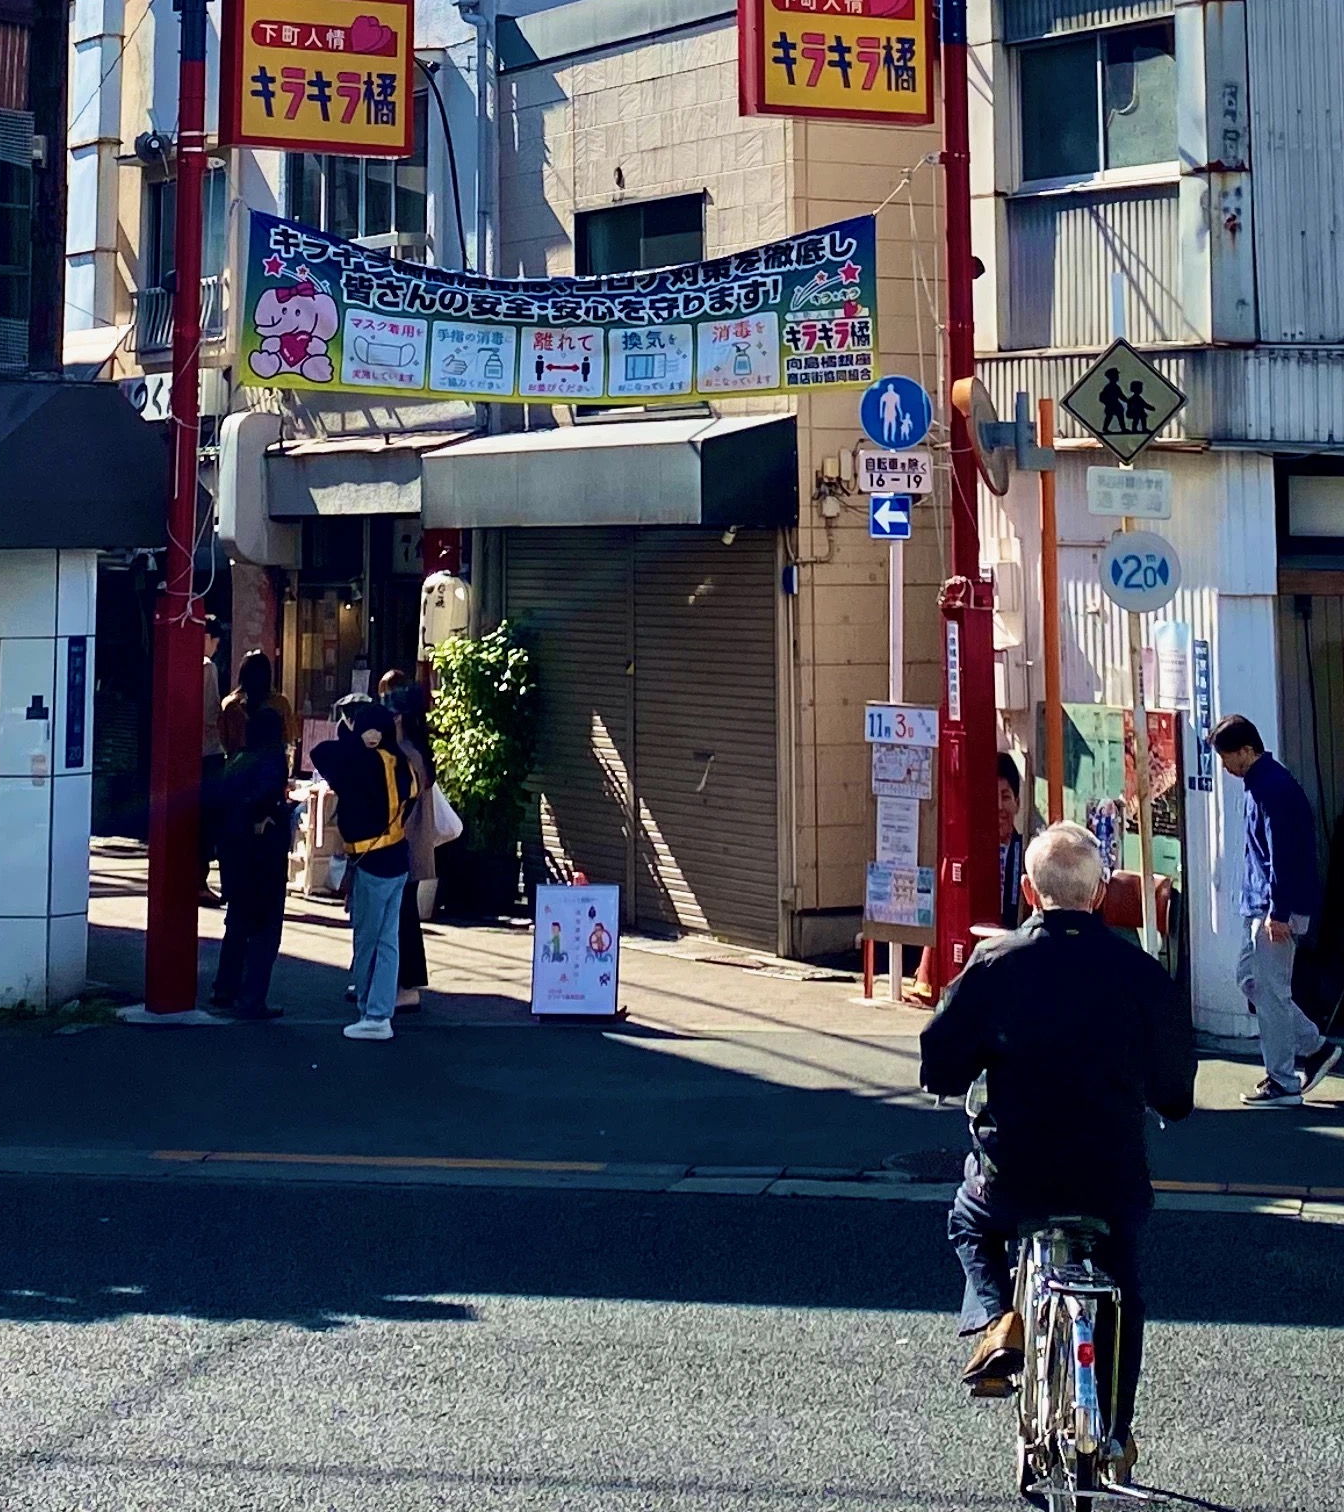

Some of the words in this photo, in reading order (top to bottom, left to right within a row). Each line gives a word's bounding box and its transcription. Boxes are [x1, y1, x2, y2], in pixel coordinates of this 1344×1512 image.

[259, 23, 346, 52] 下町人情
[771, 31, 917, 93] キラキラ橘
[250, 65, 397, 127] キラキラ橘
[533, 331, 594, 351] 離れて
[622, 330, 676, 350] 換気を
[712, 320, 765, 343] 消毒を
[785, 320, 871, 352] キラキラ橘
